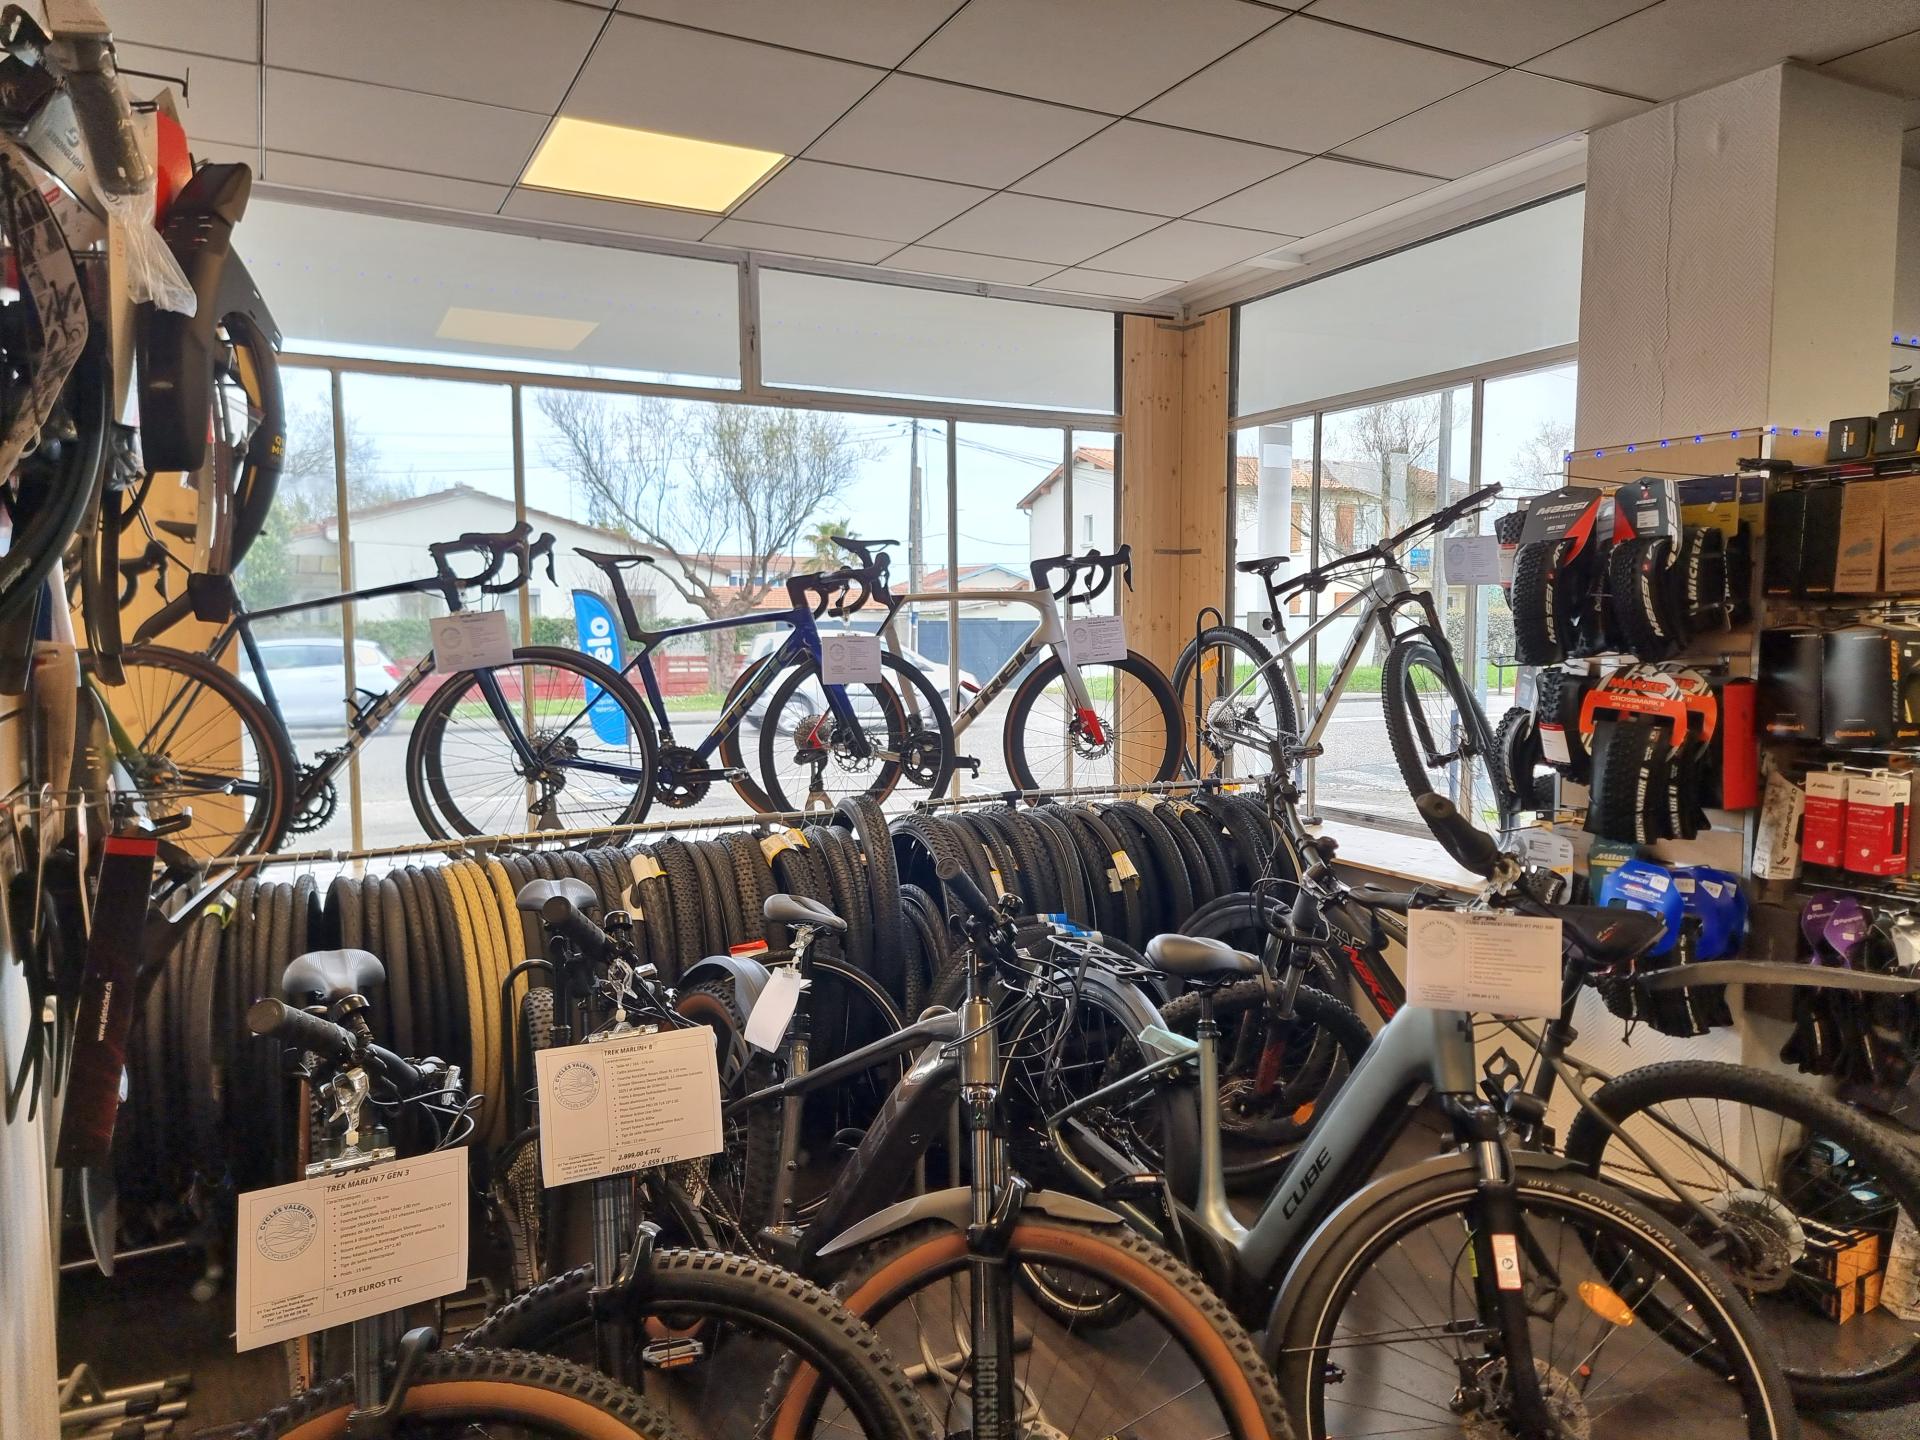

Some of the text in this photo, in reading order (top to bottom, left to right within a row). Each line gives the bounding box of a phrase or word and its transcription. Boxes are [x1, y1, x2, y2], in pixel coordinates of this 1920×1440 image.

[586, 616, 614, 670] élo
[710, 644, 796, 738] TREK
[960, 638, 1038, 719] TREK
[1609, 677, 1670, 694] MAXXIS
[620, 1045, 647, 1054] MARLIN+
[555, 1065, 572, 1083] CYCLES
[572, 1062, 597, 1077] VALENTIN
[611, 1163, 636, 1173] PROMO
[326, 1182, 346, 1193] TREK
[347, 1175, 379, 1188] MARLIN
[386, 1171, 403, 1180] GEN
[1282, 1146, 1332, 1220] CUBE
[259, 1204, 314, 1231] CYCLES VALENTIN
[1577, 1191, 1678, 1250] CONTINENTAL
[335, 1275, 403, 1299] 1.179 EUROS TTC
